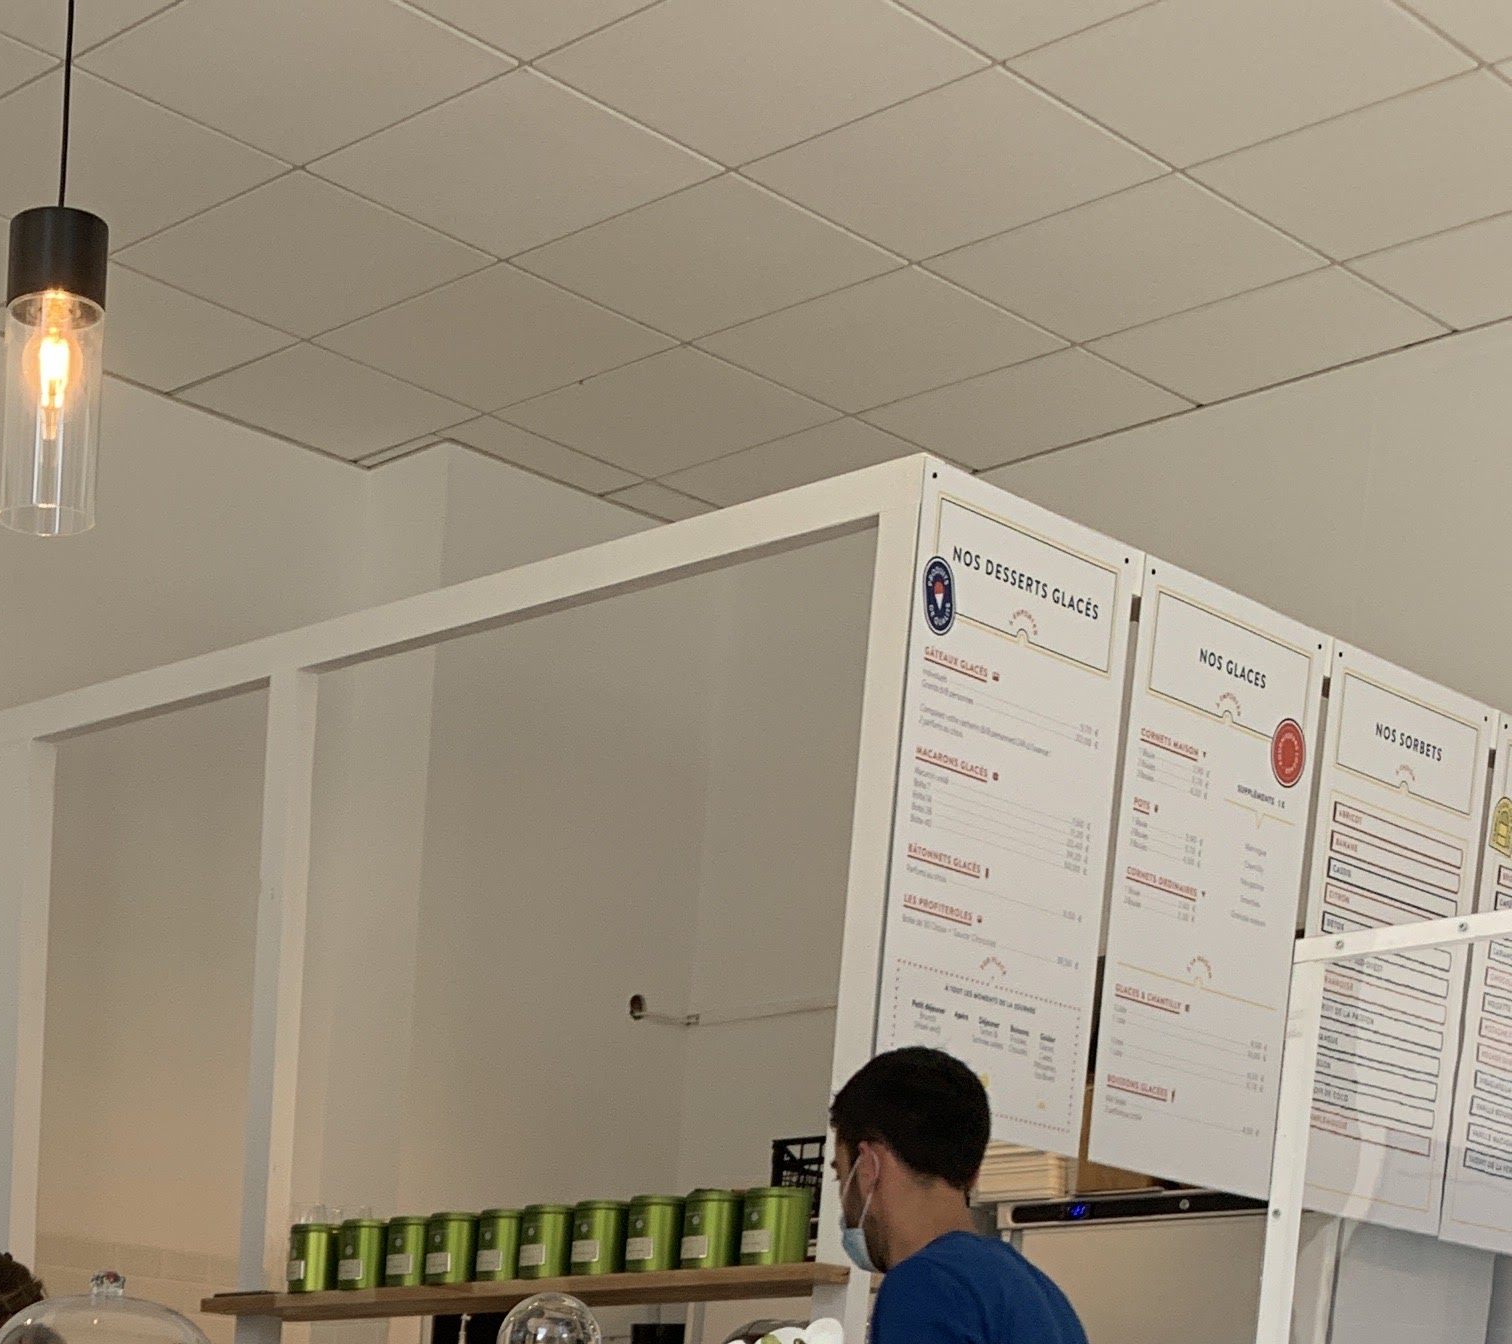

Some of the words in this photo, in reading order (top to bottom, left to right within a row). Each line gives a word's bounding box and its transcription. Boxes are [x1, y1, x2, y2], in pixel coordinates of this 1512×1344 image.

[953, 545, 981, 571] NOS
[985, 559, 1048, 599] DESSERTS
[1052, 587, 1099, 620] GLACÉS
[924, 645, 958, 666] GÂTEAUX
[960, 659, 988, 677] GLACÉS
[1199, 648, 1223, 671] NOS
[1226, 659, 1267, 689] GLACES
[1141, 727, 1172, 746] CORNETS
[1375, 721, 1396, 743] NOS
[1399, 732, 1443, 762] SORBETS
[916, 745, 958, 768] MACARONS
[960, 759, 988, 777] GLACÉS
